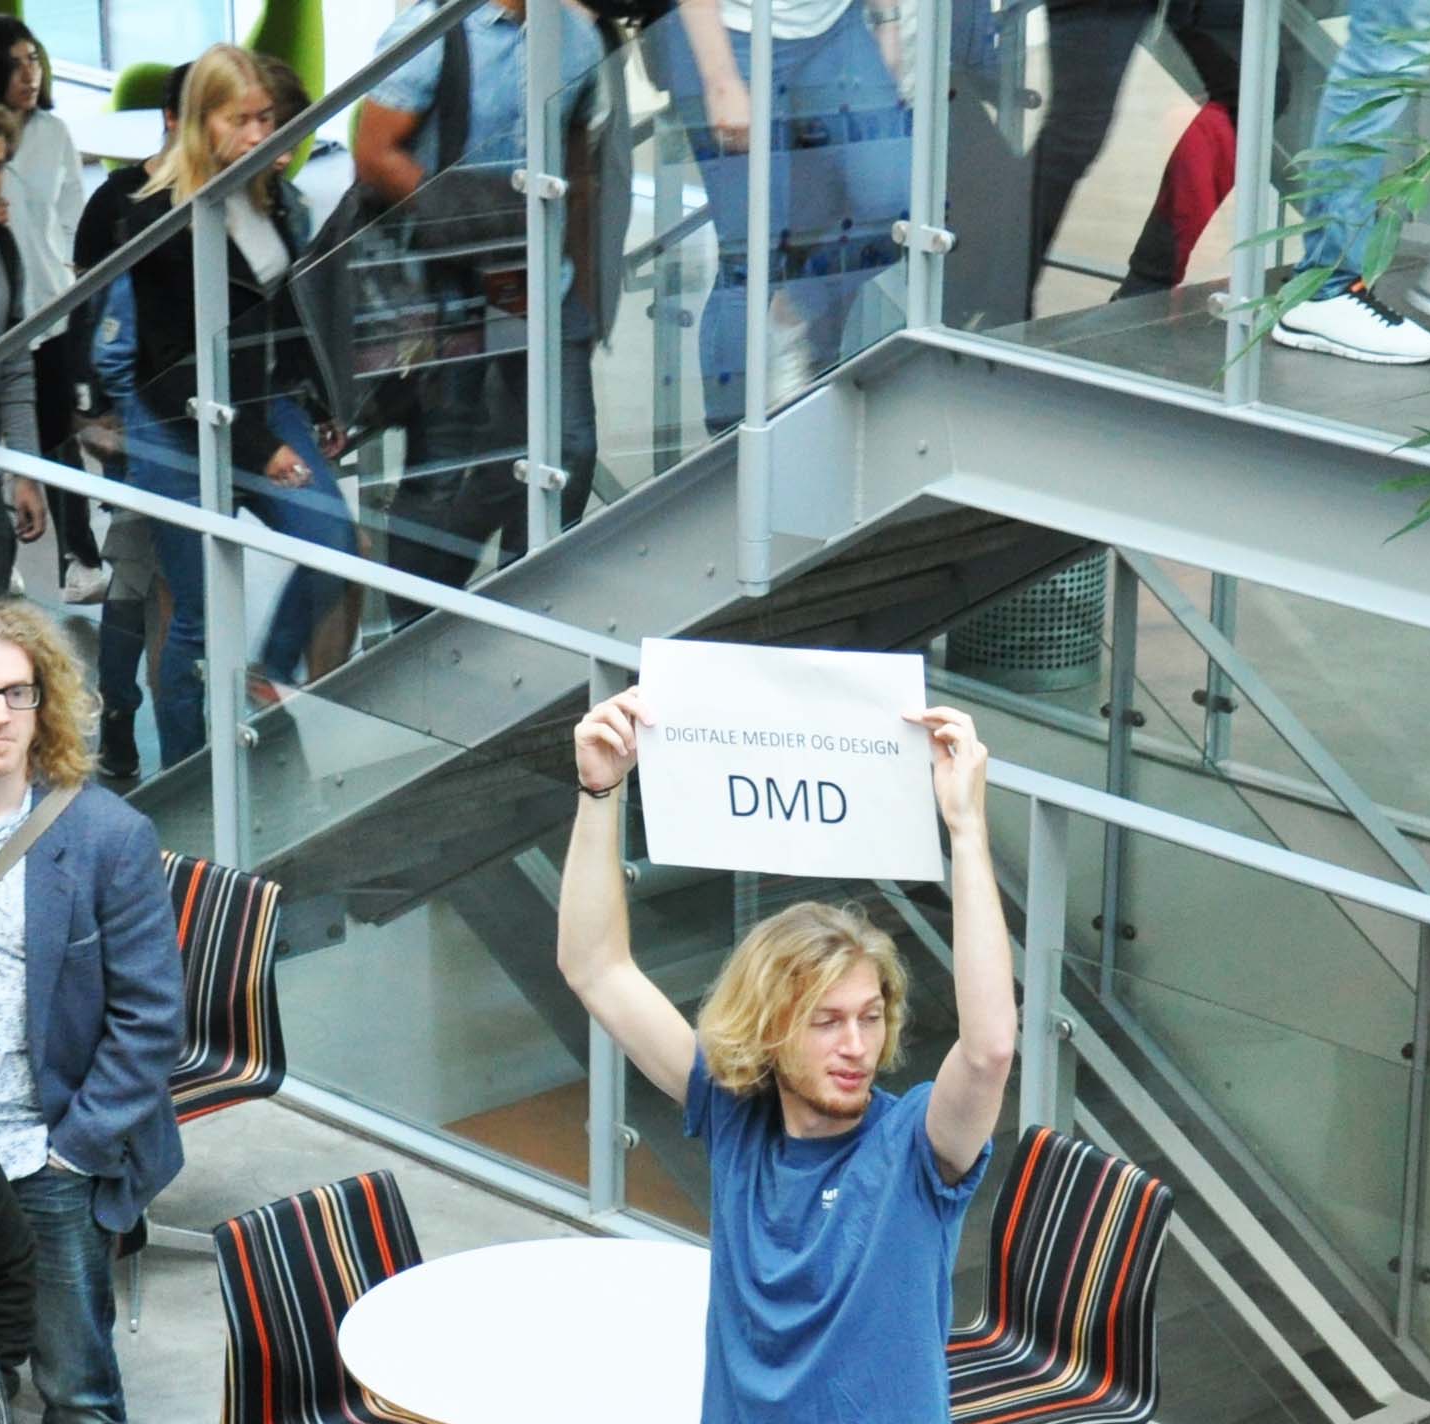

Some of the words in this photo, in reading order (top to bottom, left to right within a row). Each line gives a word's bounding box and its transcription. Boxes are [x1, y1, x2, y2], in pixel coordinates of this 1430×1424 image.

[665, 726, 738, 745] DIGITALE
[742, 730, 806, 749] MEDIER
[811, 733, 835, 751] OG
[839, 736, 899, 755] DESIGN
[728, 774, 847, 824] DMD
